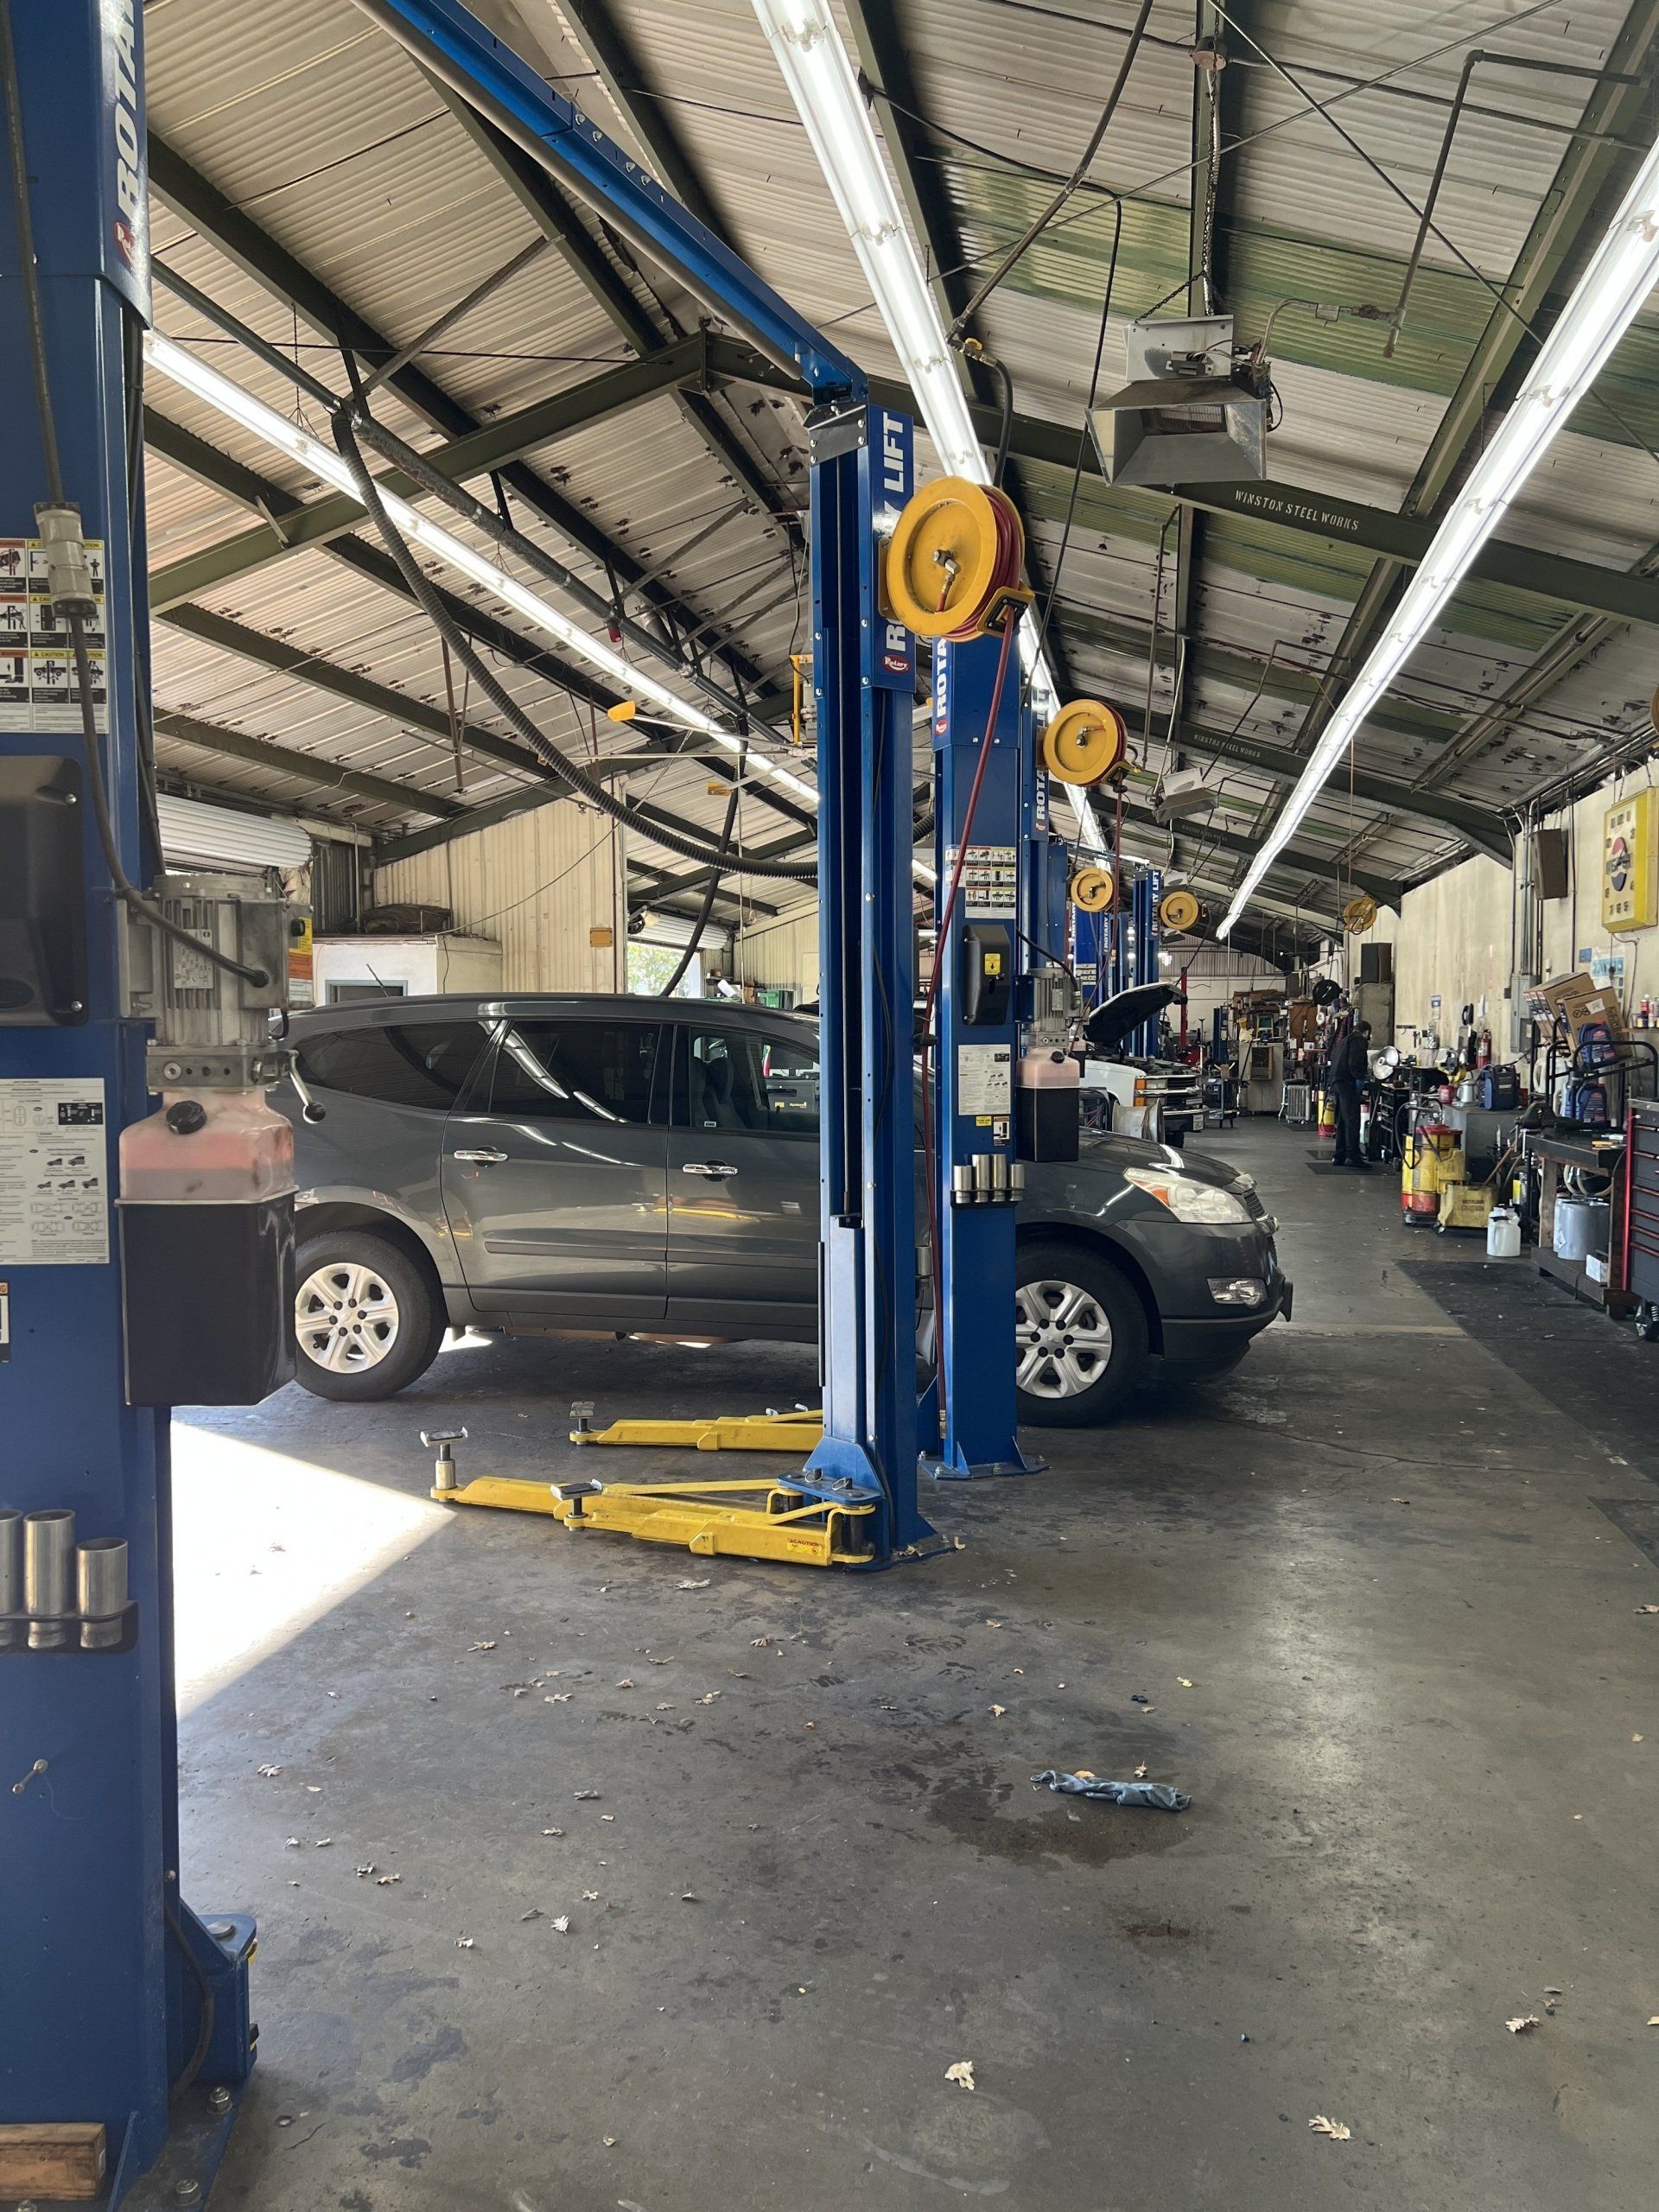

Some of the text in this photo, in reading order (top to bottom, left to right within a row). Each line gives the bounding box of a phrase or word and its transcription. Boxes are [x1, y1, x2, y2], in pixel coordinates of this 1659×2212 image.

[883, 411, 906, 493] LIFT
[1235, 489, 1359, 531] WINSTON STEEL WORKS
